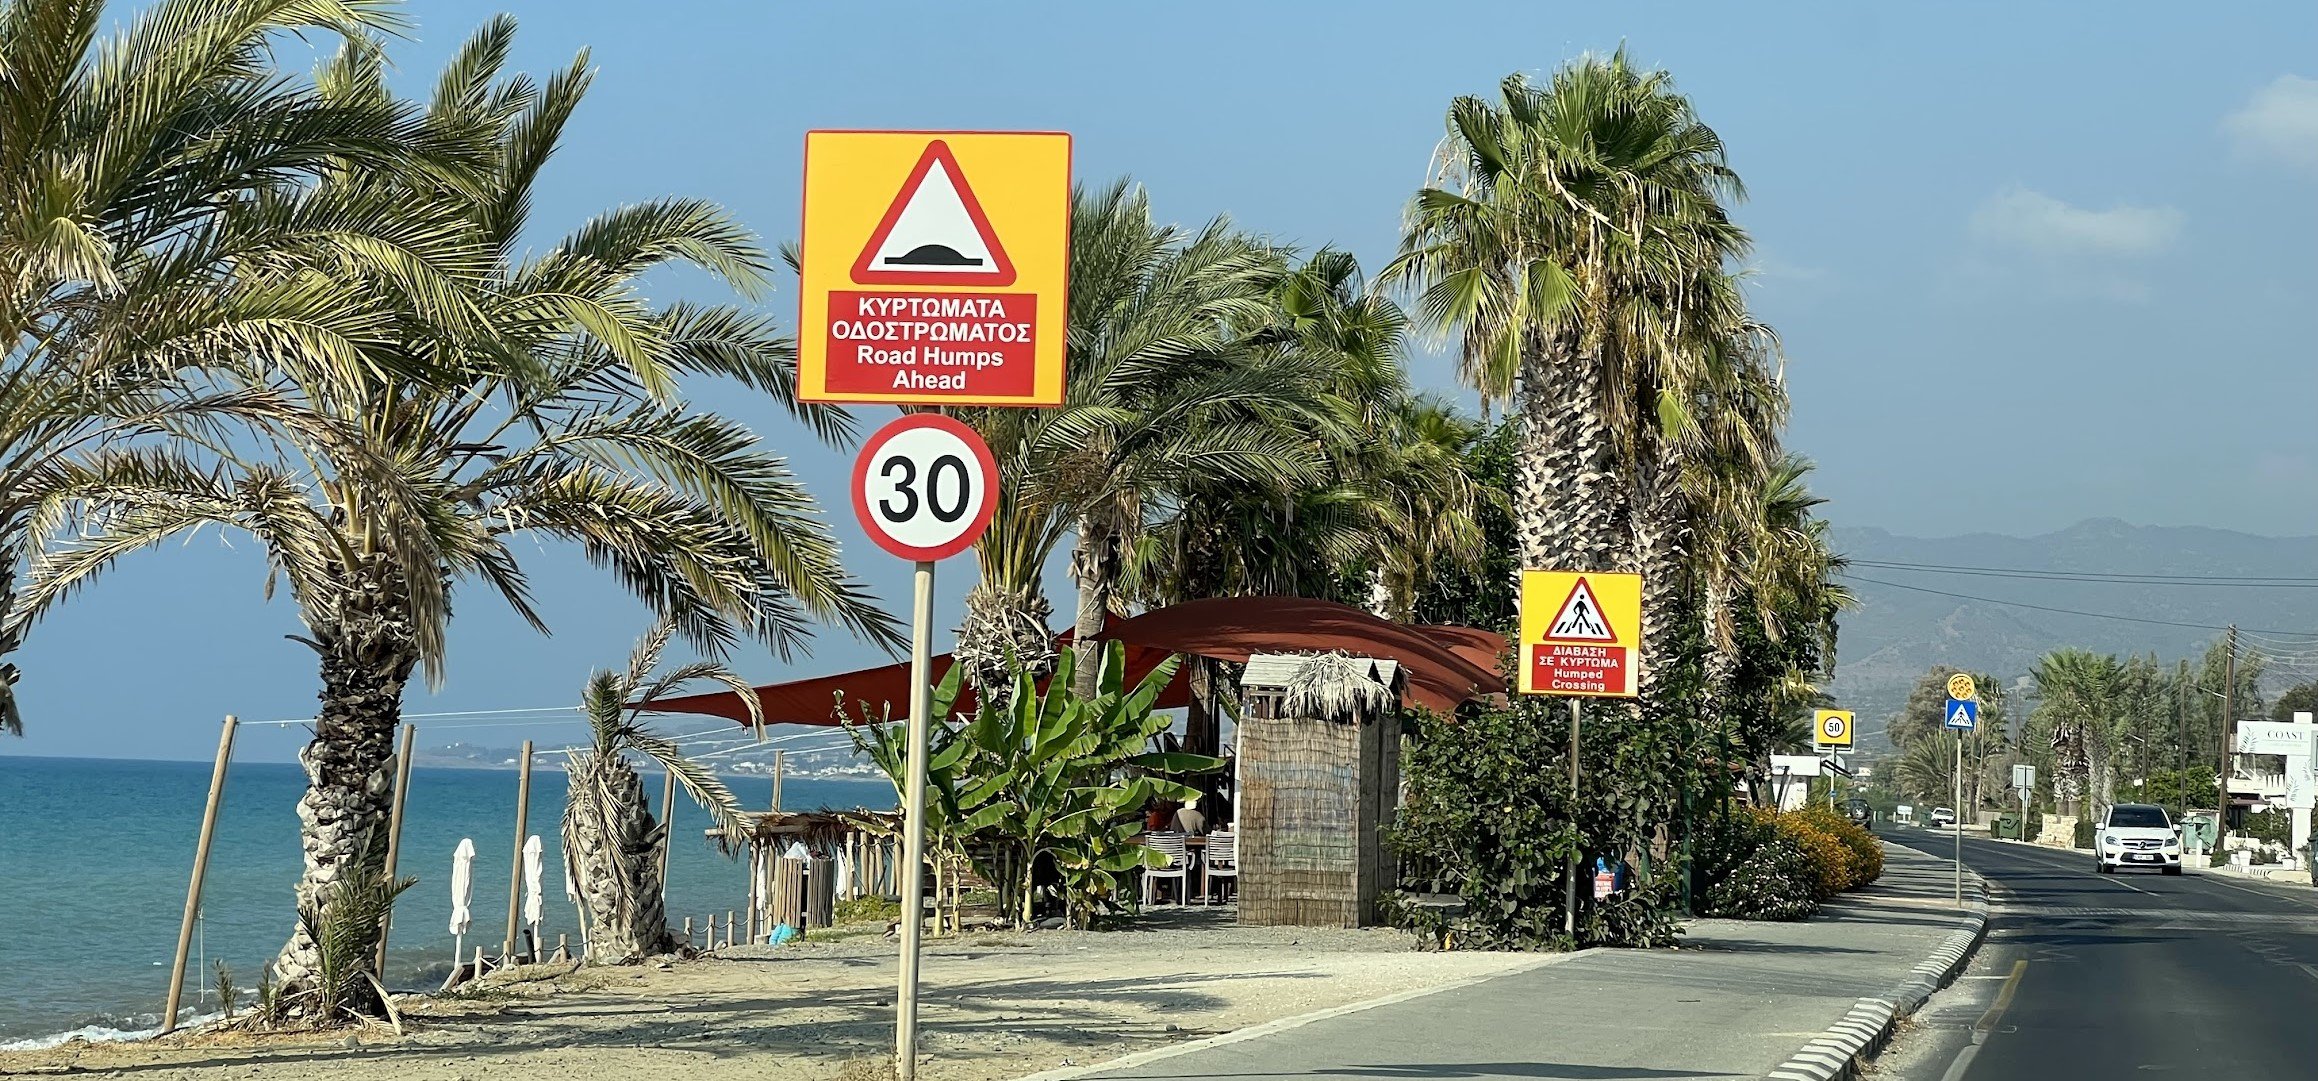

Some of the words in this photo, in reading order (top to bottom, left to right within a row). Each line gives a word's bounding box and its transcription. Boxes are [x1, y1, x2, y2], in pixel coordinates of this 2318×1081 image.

[858, 297, 1006, 318] ΚΥΡΤΩΜΑΤΑ
[831, 320, 1031, 343] ΟΔΟΣΤΡΩΜΑΤΟΣ
[857, 345, 917, 365] Road
[923, 346, 1004, 371] Humps
[892, 369, 966, 390] Ahead
[879, 454, 970, 523] 30
[1553, 646, 1607, 657] ΔΙΑΒΑΣΗ
[1539, 656, 1554, 666] ΣΕ
[1560, 657, 1619, 668] ΚΥΡΤΩΜΑ
[1554, 668, 1604, 680] Humped
[1551, 680, 1605, 692] Crossing
[1828, 722, 1840, 732] 50
[2267, 730, 2304, 740] COAST
